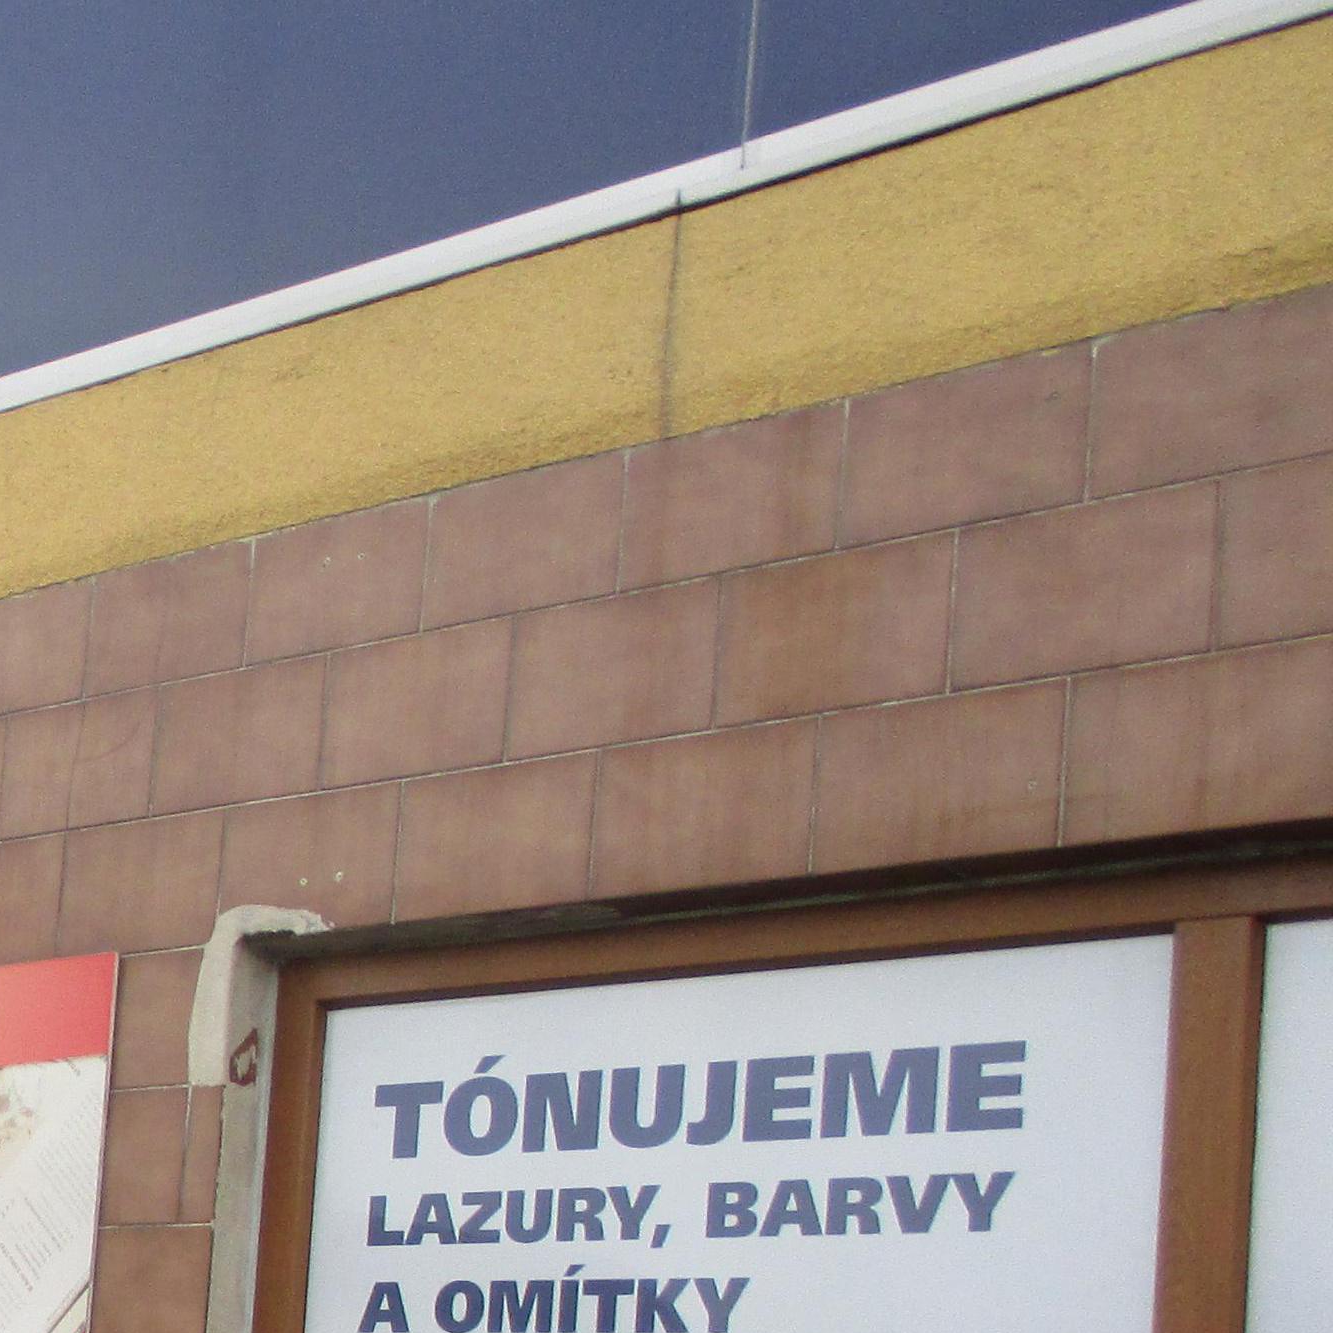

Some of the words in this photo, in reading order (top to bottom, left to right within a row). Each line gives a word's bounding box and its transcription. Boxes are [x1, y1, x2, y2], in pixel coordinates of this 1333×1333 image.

[374, 1040, 1028, 1160] TÓNUJEME
[366, 1182, 671, 1248] LAZURY,
[705, 1171, 1016, 1239] BARVY
